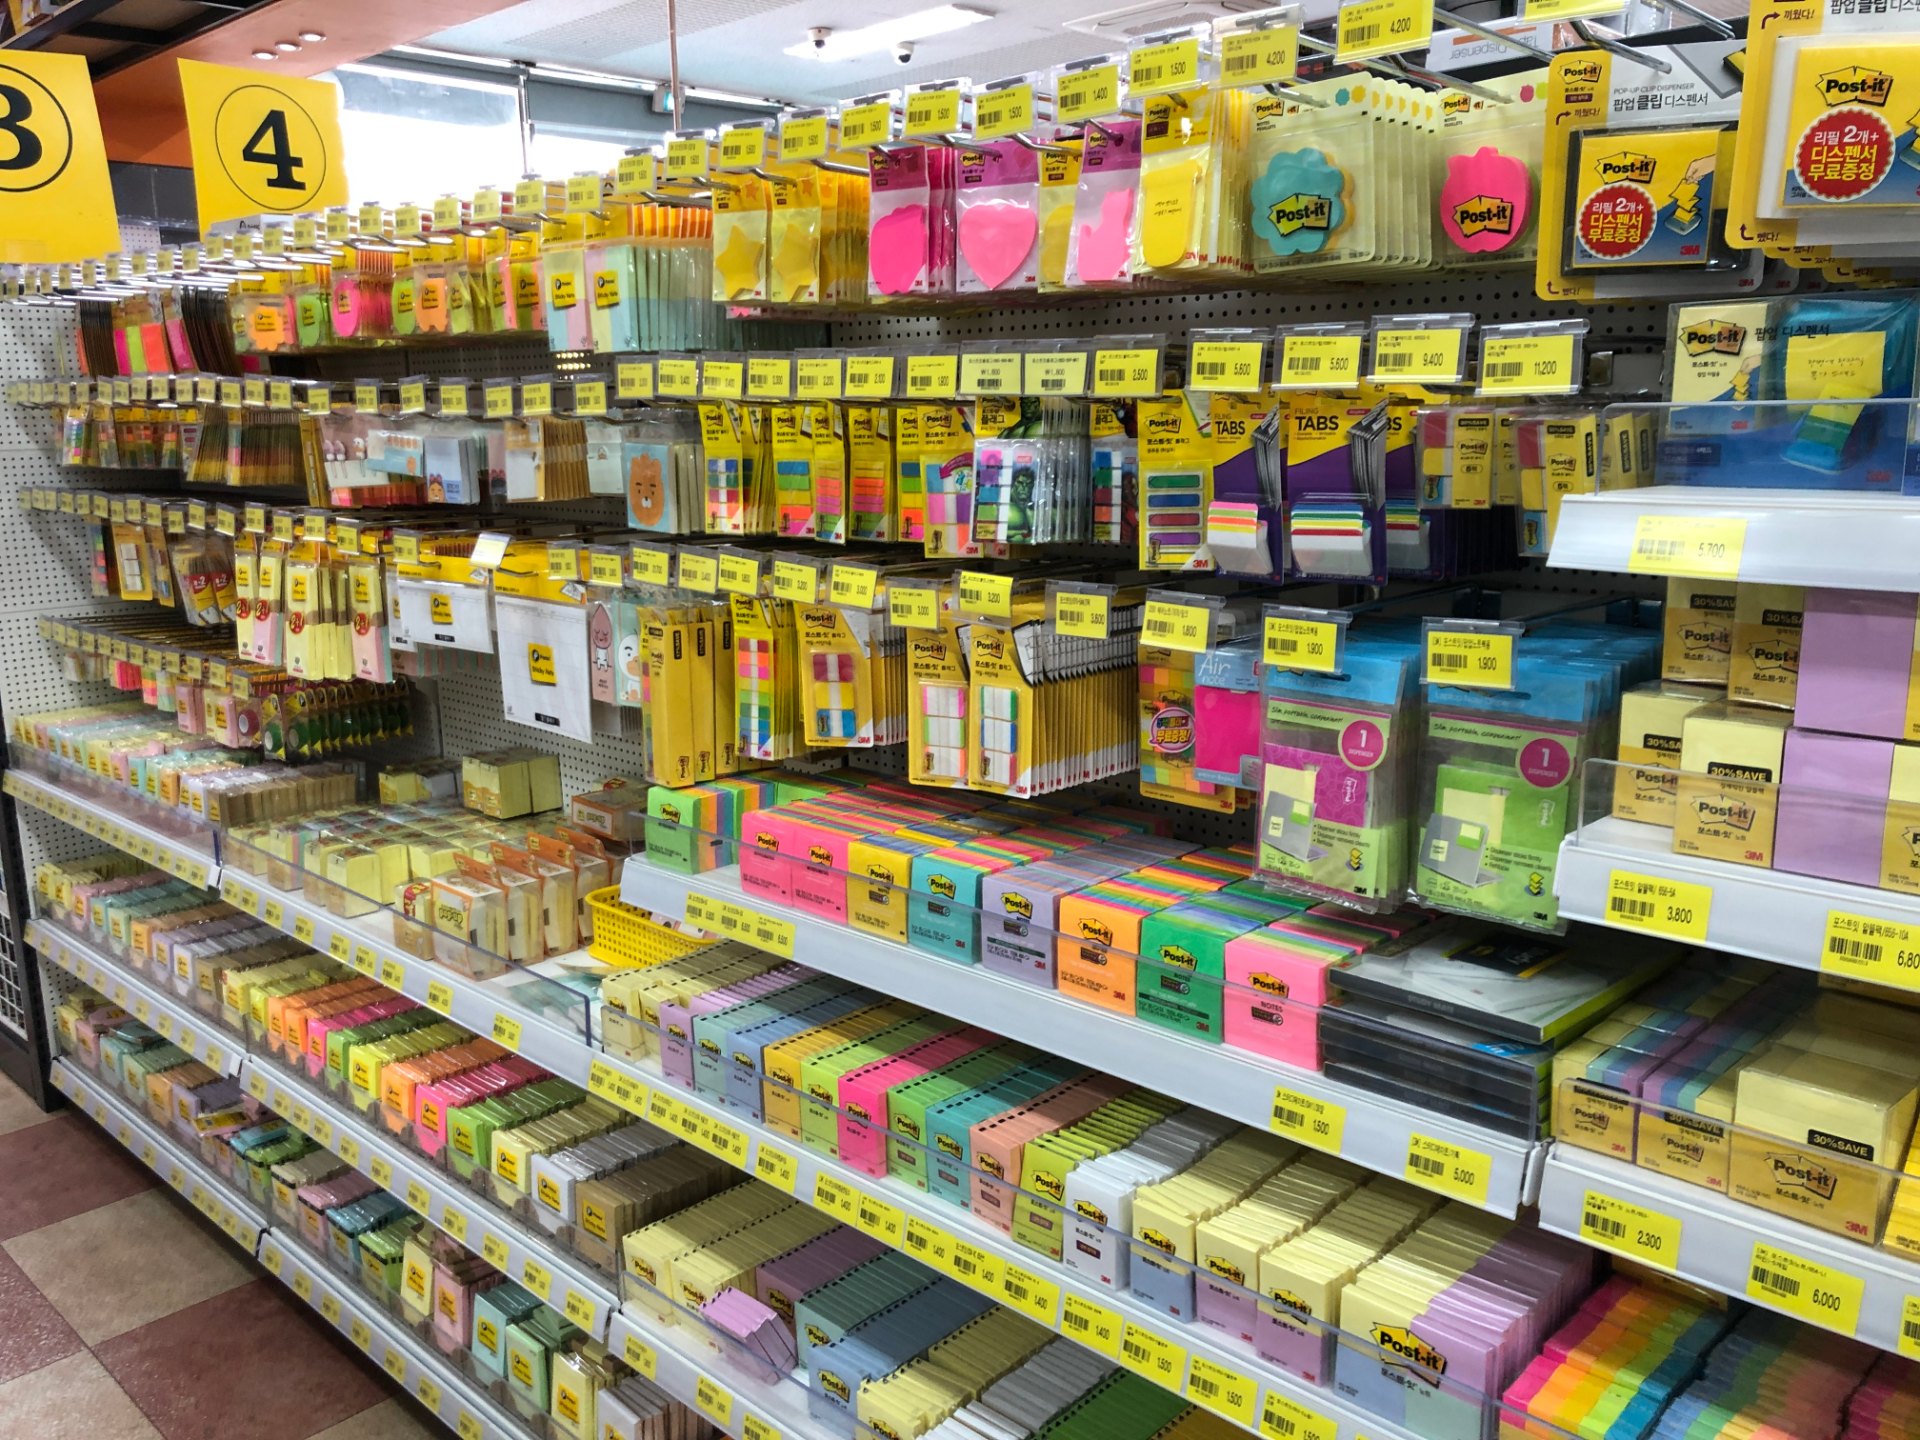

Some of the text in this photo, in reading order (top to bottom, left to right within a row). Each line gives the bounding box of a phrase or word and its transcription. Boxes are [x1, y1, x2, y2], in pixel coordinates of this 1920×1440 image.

[1390, 17, 1411, 34] 4,200
[1266, 51, 1285, 66] 4,200
[1170, 61, 1186, 75] 1,500
[1563, 66, 1598, 78] Post-it
[1092, 86, 1108, 101] 1,400
[1656, 82, 1695, 91] DISPENSER
[1825, 77, 1888, 96] Post-it
[1256, 101, 1282, 113] Post-it
[1444, 97, 1469, 110] Post-it
[1613, 91, 1709, 112] 팝업 클립 디스펜서
[937, 107, 950, 121] 1,500
[1008, 105, 1022, 120] 1,500
[870, 120, 881, 132] 1,500
[1814, 131, 1839, 145] 리필
[242, 109, 306, 191] 4
[1811, 146, 1877, 164] 디스펜서
[1602, 160, 1653, 175] Post-it
[1808, 163, 1876, 182] 무료증정
[1275, 204, 1326, 224] Post-it
[1591, 201, 1613, 213] 리필
[1459, 206, 1508, 225] Post-it
[1590, 214, 1642, 227] 디스펜서
[1588, 227, 1640, 241] 무료증정
[1680, 244, 1700, 256] 3M
[1687, 331, 1740, 344] Post-it
[1782, 324, 1830, 339] 디스펜서
[1330, 357, 1349, 371] 5,600
[1423, 352, 1443, 367] 9,400
[1133, 368, 1148, 382] 2,500
[1234, 363, 1251, 376] 5,600
[1534, 361, 1557, 375] 11,200
[926, 414, 952, 424] Post-it
[981, 414, 1005, 424] 플래그
[1148, 419, 1180, 428] Post-it
[1295, 416, 1339, 431] TABS
[1732, 420, 1748, 430] 3M
[1215, 420, 1245, 434] TABS
[1192, 559, 1208, 569] 3M
[805, 614, 836, 624] Post-it
[1684, 629, 1730, 645] Post-it
[914, 642, 944, 654] Post-it
[976, 640, 1001, 652] Post-it
[1307, 642, 1322, 656] 1,900
[1200, 656, 1230, 677] Air
[1478, 657, 1497, 670] 1,900
[1202, 676, 1226, 685] note
[1156, 729, 1192, 744] 무료증정!
[1359, 730, 1367, 747] 1
[1541, 748, 1549, 767] 1
[1711, 766, 1767, 782] 30%SAVE
[1698, 801, 1750, 821] Post-it
[757, 835, 779, 850] Post-it
[811, 850, 832, 865] Post-it
[1744, 850, 1764, 863] 3M
[870, 867, 894, 882] Post-it
[929, 879, 955, 895] Post-it
[1004, 896, 1032, 915] Post-it
[1666, 905, 1692, 925] 3,800
[1082, 923, 1112, 942] Post-it
[1163, 950, 1196, 968] Post-it
[1897, 948, 1920, 969] 6,80
[1251, 977, 1288, 997] Post-it
[1260, 1000, 1284, 1013] NOTES
[896, 1118, 919, 1134] Post-it
[1313, 1119, 1330, 1136] 1,500
[937, 1136, 962, 1152] Post-it
[1612, 1142, 1627, 1154] 3M
[1813, 1133, 1868, 1158] 30%SAVE
[980, 1154, 1004, 1172] Post-it
[1453, 1168, 1475, 1186] 5,000
[1773, 1158, 1832, 1188] Post-it
[1035, 1174, 1062, 1192] Post-it
[1706, 1176, 1722, 1188] 3M
[1076, 1202, 1107, 1222] Post-it
[1845, 1221, 1868, 1237] 3M
[1143, 1231, 1172, 1251] Post-it
[1637, 1230, 1662, 1251] 2,300
[933, 1244, 945, 1260] 1,400
[1050, 1246, 1060, 1257] 3M
[982, 1268, 994, 1284] 1,400
[1209, 1258, 1243, 1281] Post-it
[1100, 1274, 1111, 1285] 3M
[1034, 1295, 1048, 1310] 1,400
[1274, 1292, 1310, 1316] Post-it
[1812, 1288, 1841, 1312] 6,000
[1169, 1305, 1181, 1317] 3M
[1096, 1324, 1110, 1340] 1,400
[1240, 1332, 1254, 1343] 3M
[1379, 1331, 1442, 1369] Post-it
[1157, 1356, 1172, 1374] 1,500
[1226, 1390, 1242, 1408] 1,500
